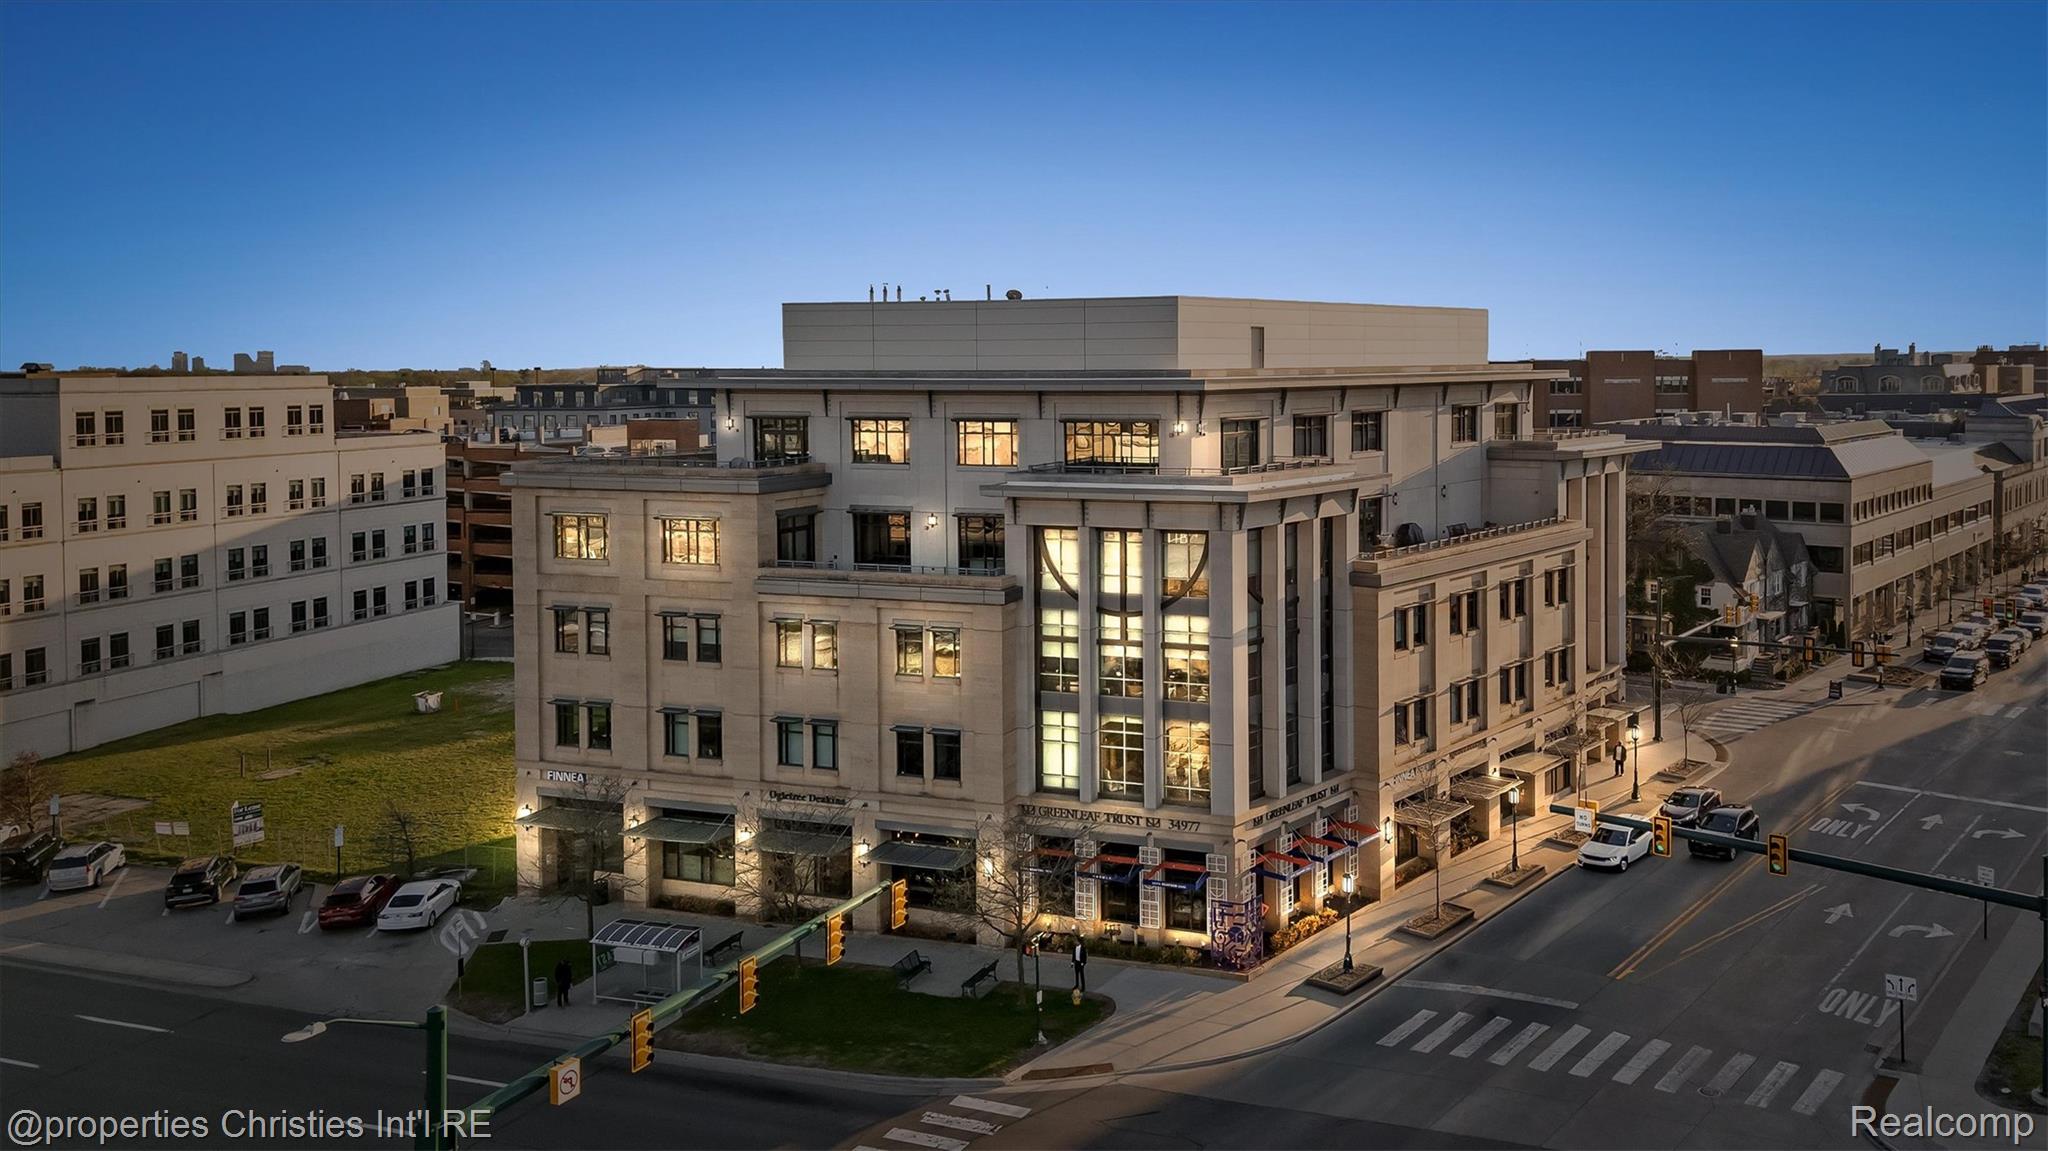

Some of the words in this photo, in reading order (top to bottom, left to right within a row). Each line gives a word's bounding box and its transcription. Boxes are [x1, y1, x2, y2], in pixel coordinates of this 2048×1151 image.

[547, 770, 584, 783] FINNEA
[1265, 799, 1304, 821] GREENLEAF
[1305, 788, 1328, 804] TRUST
[1038, 806, 1101, 822] GREENLEAF
[1103, 812, 1143, 826] TRUST
[1168, 818, 1201, 832] 34977
[1808, 817, 1873, 839] ONLY
[1819, 988, 1900, 1028] ONLY
